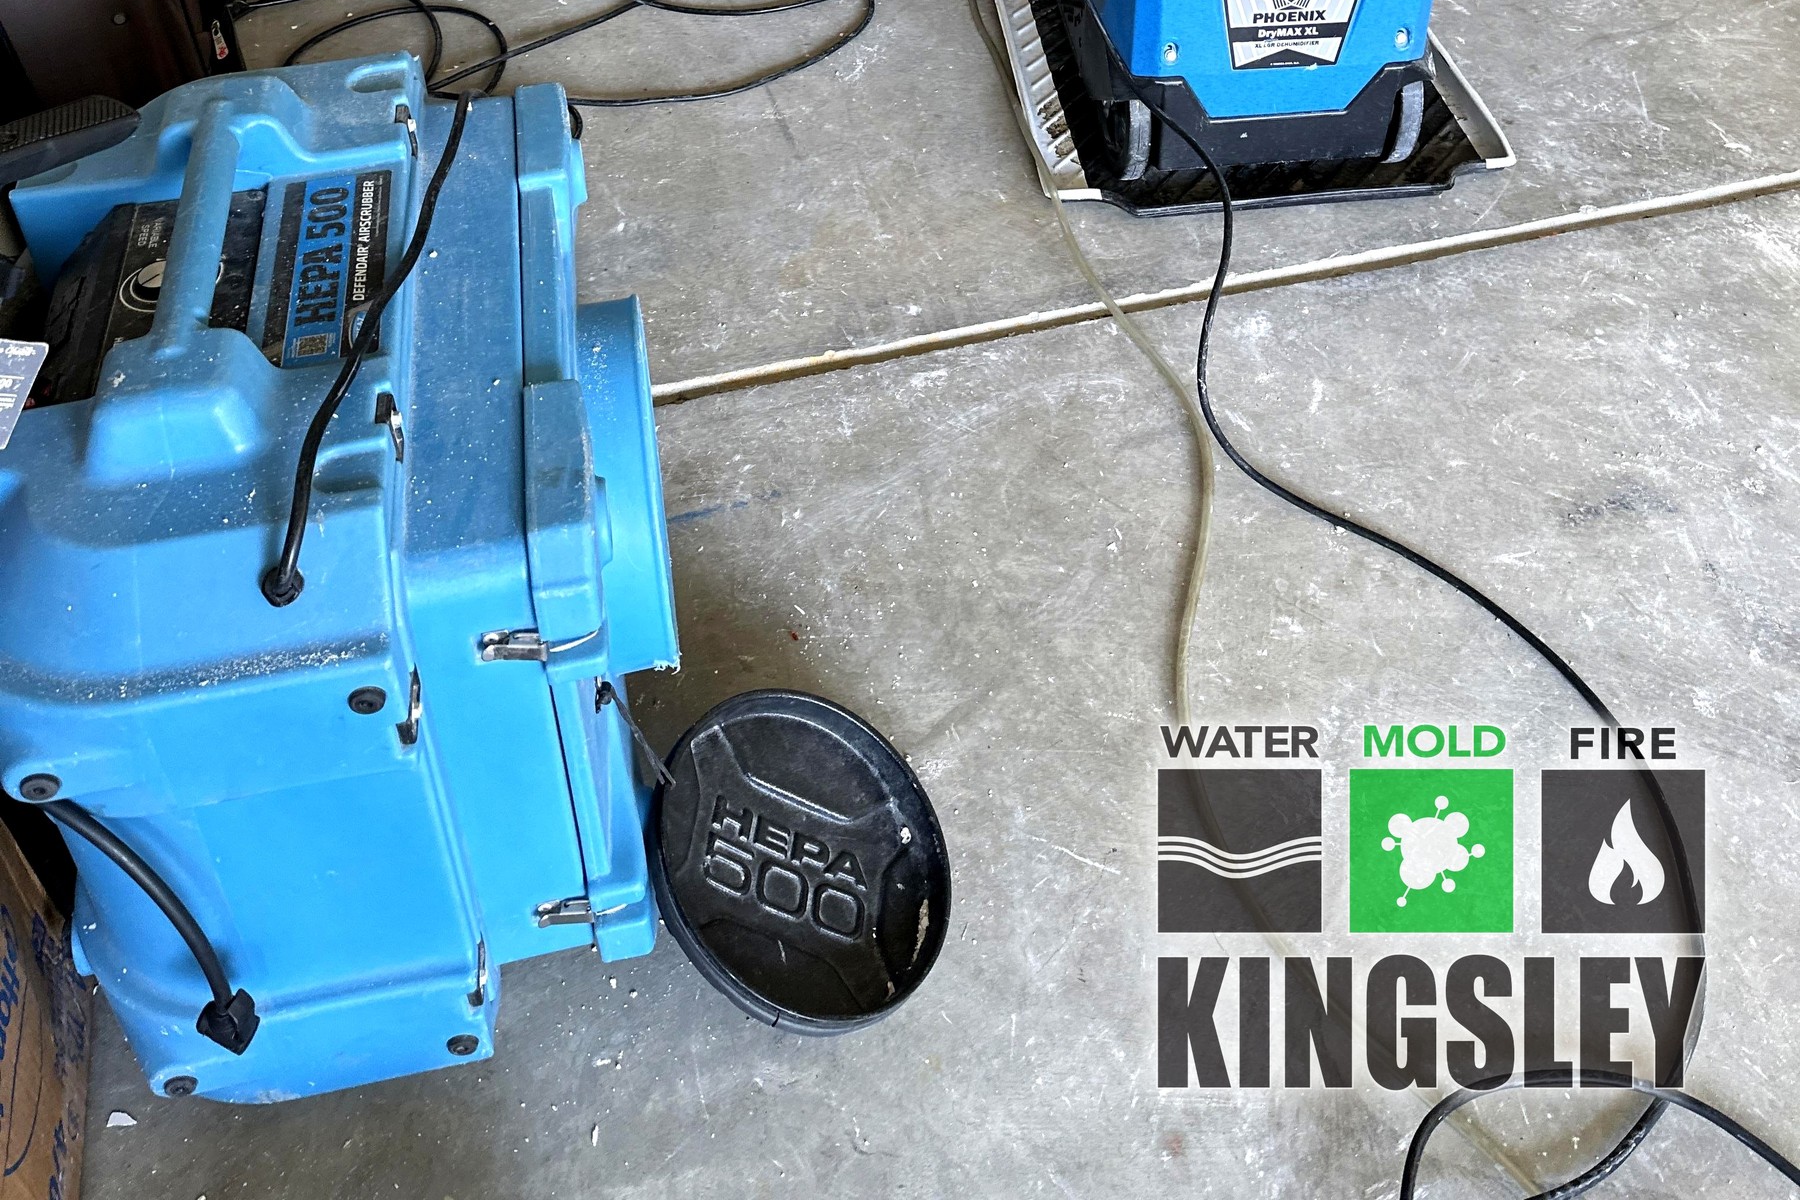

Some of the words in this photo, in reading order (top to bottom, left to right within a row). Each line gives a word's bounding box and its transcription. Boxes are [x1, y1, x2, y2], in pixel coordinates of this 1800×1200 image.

[1253, 10, 1327, 24] PHOENIX
[1258, 27, 1302, 38] DryMAX
[1303, 26, 1319, 36] XL
[1276, 40, 1320, 48] DEHUMIDIFIER
[147, 216, 165, 249] VARIABLE
[306, 186, 349, 240] 500
[359, 179, 375, 244] AIRSCRUBBER
[137, 224, 150, 247] SPEED
[294, 242, 343, 327] HEPA
[711, 794, 868, 891] HEPA
[703, 831, 866, 943] 500
